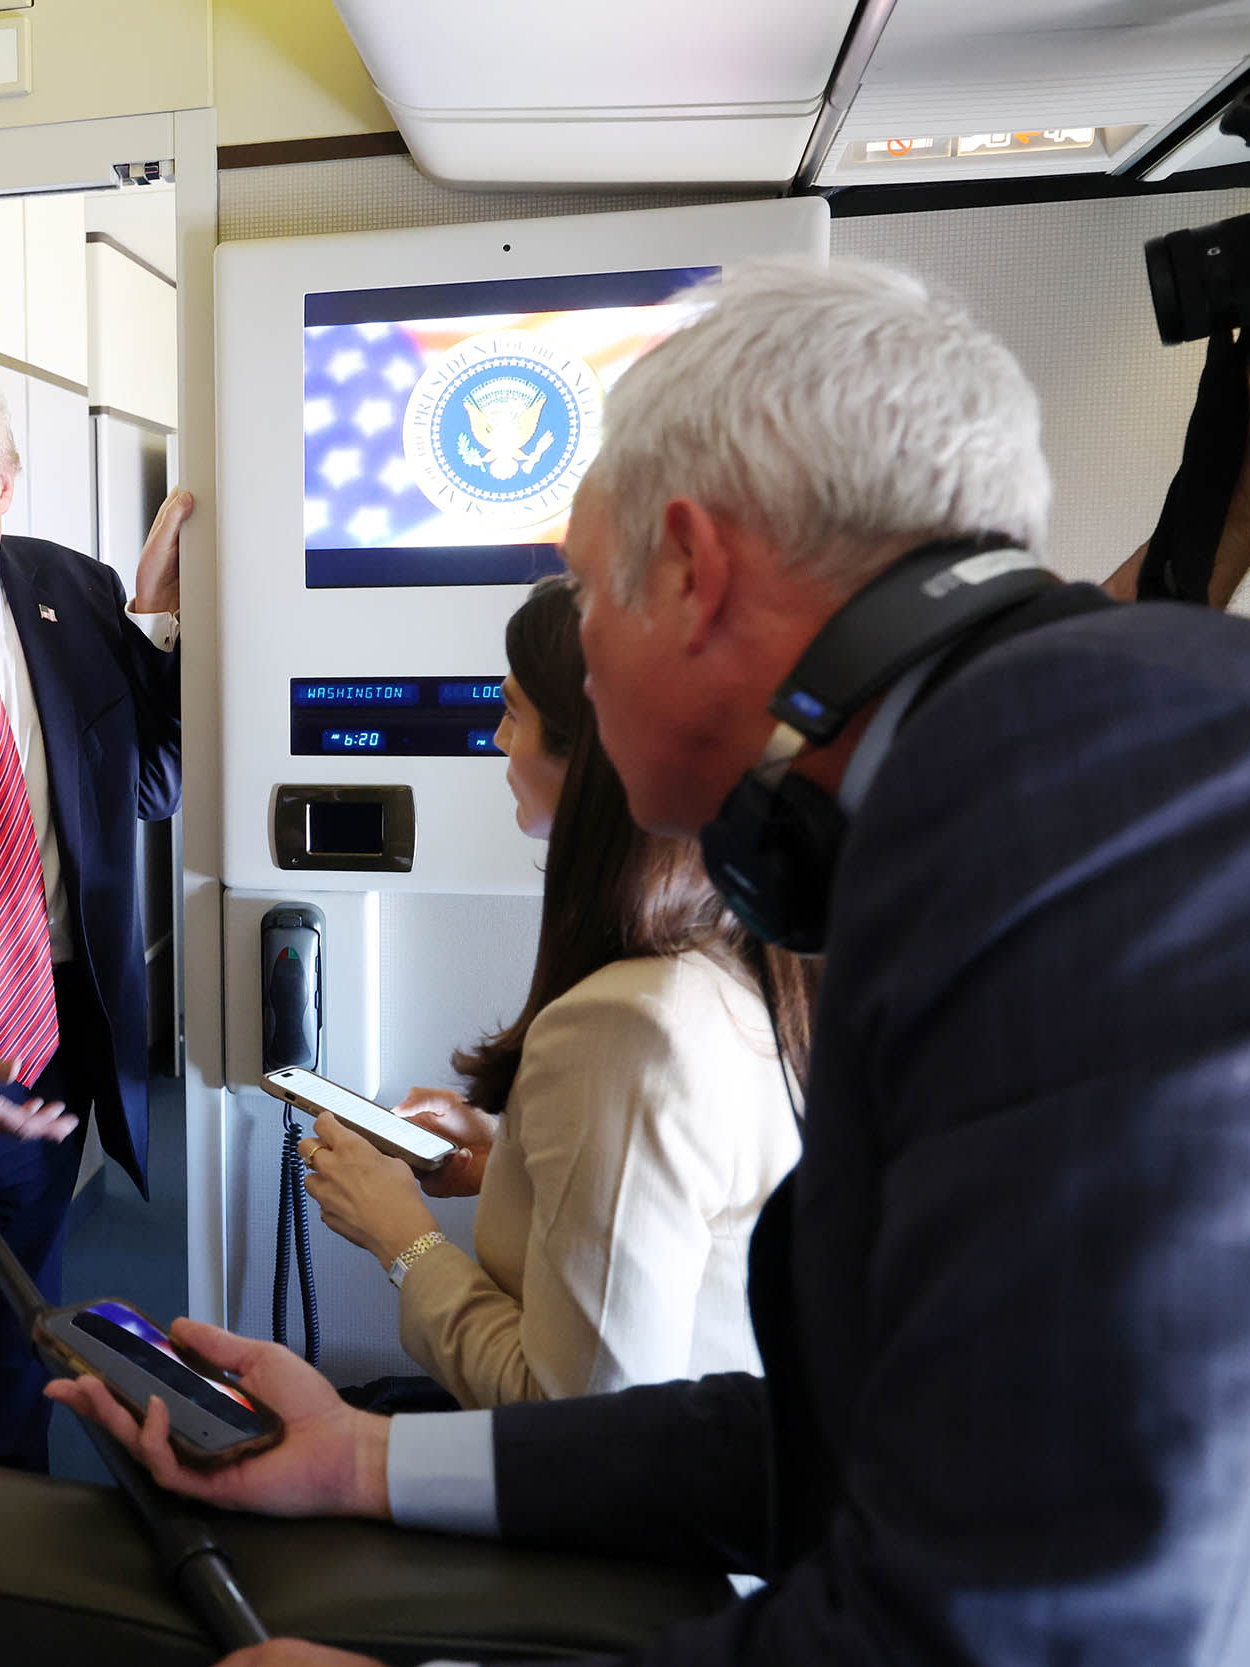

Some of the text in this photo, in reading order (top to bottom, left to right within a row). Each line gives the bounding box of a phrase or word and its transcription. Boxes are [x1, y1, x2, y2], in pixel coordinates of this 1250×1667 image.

[307, 687, 403, 699] WASHINGTON
[472, 686, 502, 699] LOC
[344, 732, 380, 746] 6:20
